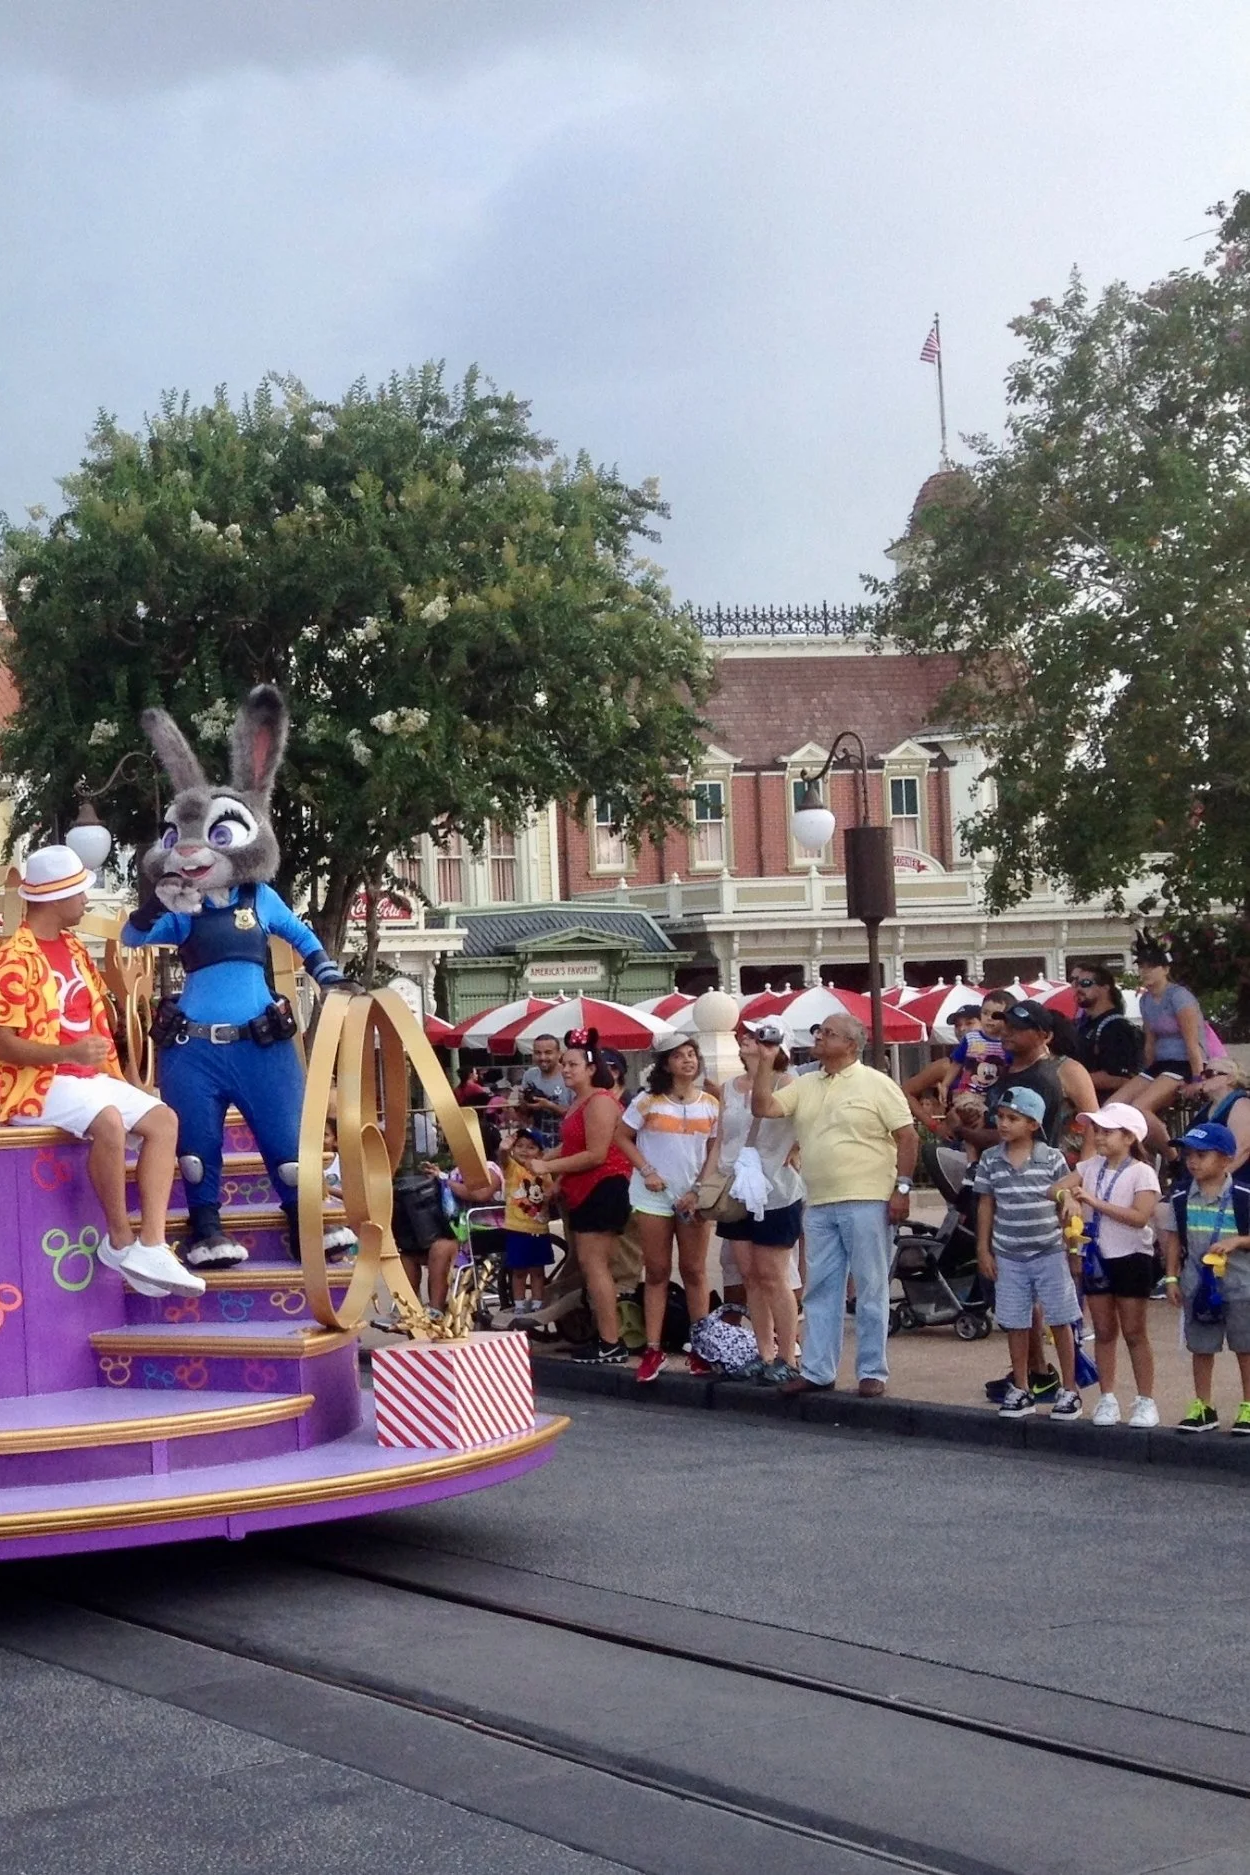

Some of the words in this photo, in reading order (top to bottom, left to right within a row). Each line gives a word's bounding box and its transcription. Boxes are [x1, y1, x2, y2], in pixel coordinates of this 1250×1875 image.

[351, 898, 401, 917] CocCola
[531, 967, 565, 976] AMERICA'S
[567, 966, 598, 975] FAVORITE
